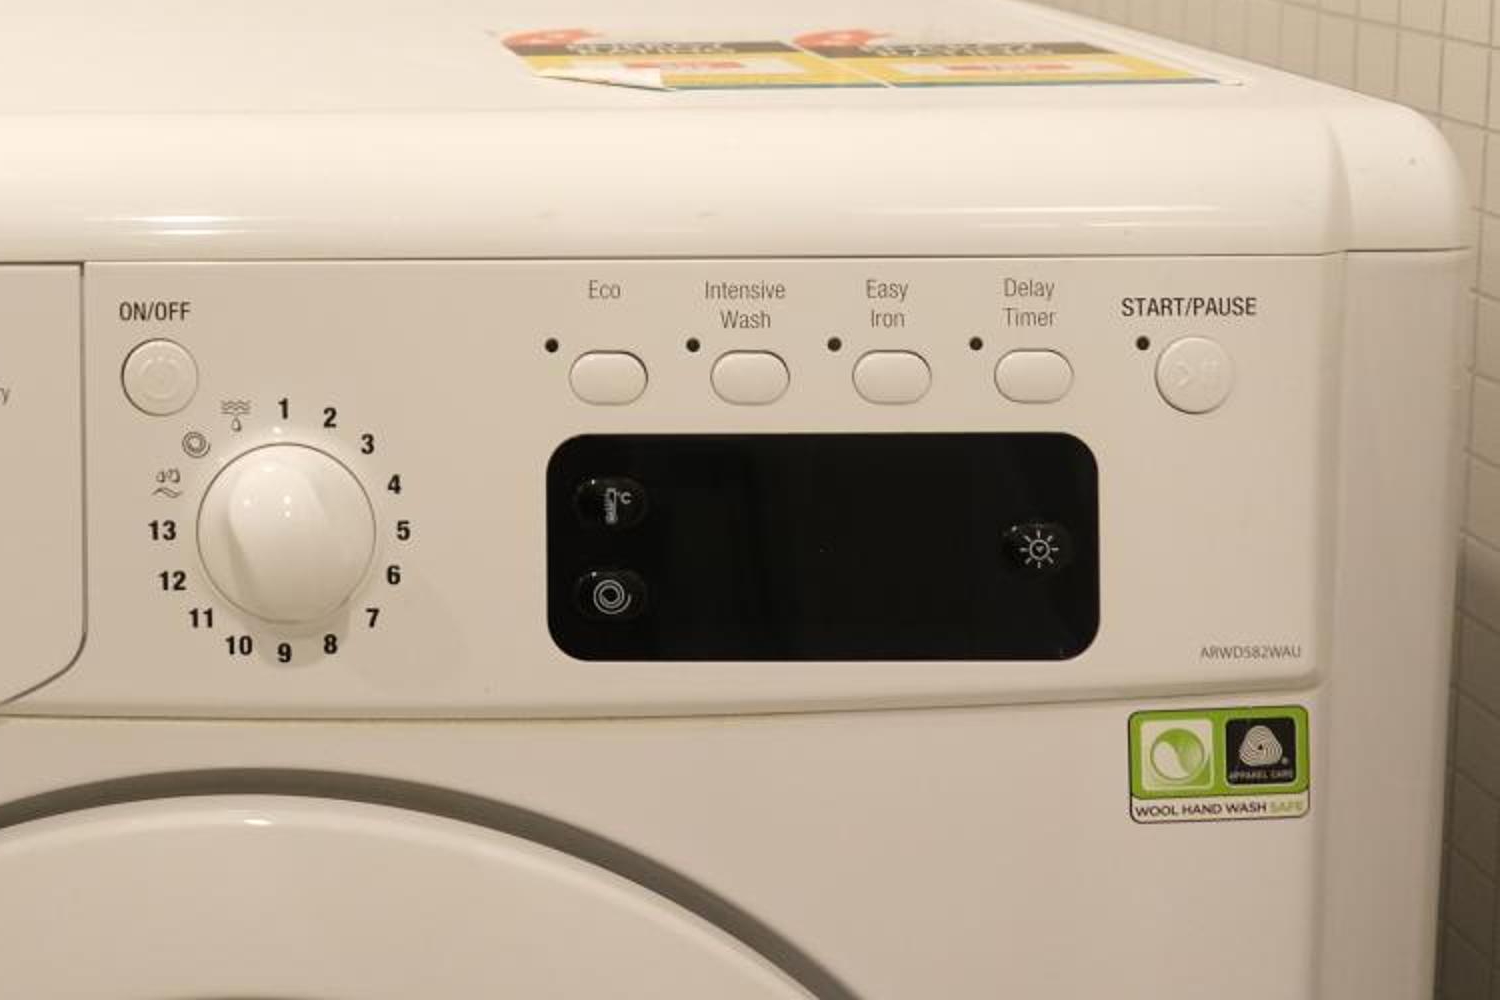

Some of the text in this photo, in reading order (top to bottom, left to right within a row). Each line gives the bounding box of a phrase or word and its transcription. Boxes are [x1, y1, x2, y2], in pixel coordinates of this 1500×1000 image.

[589, 280, 620, 299] Eco
[705, 280, 785, 299] Intensive
[866, 279, 908, 302] Easy
[1004, 278, 1054, 301] Delay
[120, 302, 190, 321] ON/OFF
[1122, 297, 1256, 316] START/PAUSE
[720, 310, 770, 328] Wash
[871, 309, 904, 328] Iron
[1003, 308, 1056, 326] Timer
[279, 398, 288, 419] 1
[324, 408, 336, 428] 2
[361, 434, 374, 454] 3
[388, 474, 401, 494] 4
[149, 520, 176, 540] 13
[397, 520, 410, 540] 5
[160, 571, 186, 590] 12
[387, 565, 400, 585] 6
[189, 608, 212, 628] 11
[366, 608, 379, 628] 7
[226, 636, 252, 655] 10
[278, 643, 292, 663] 9
[324, 634, 337, 654] 8
[1136, 801, 1302, 817] WOOL HAND WASH SAFE
